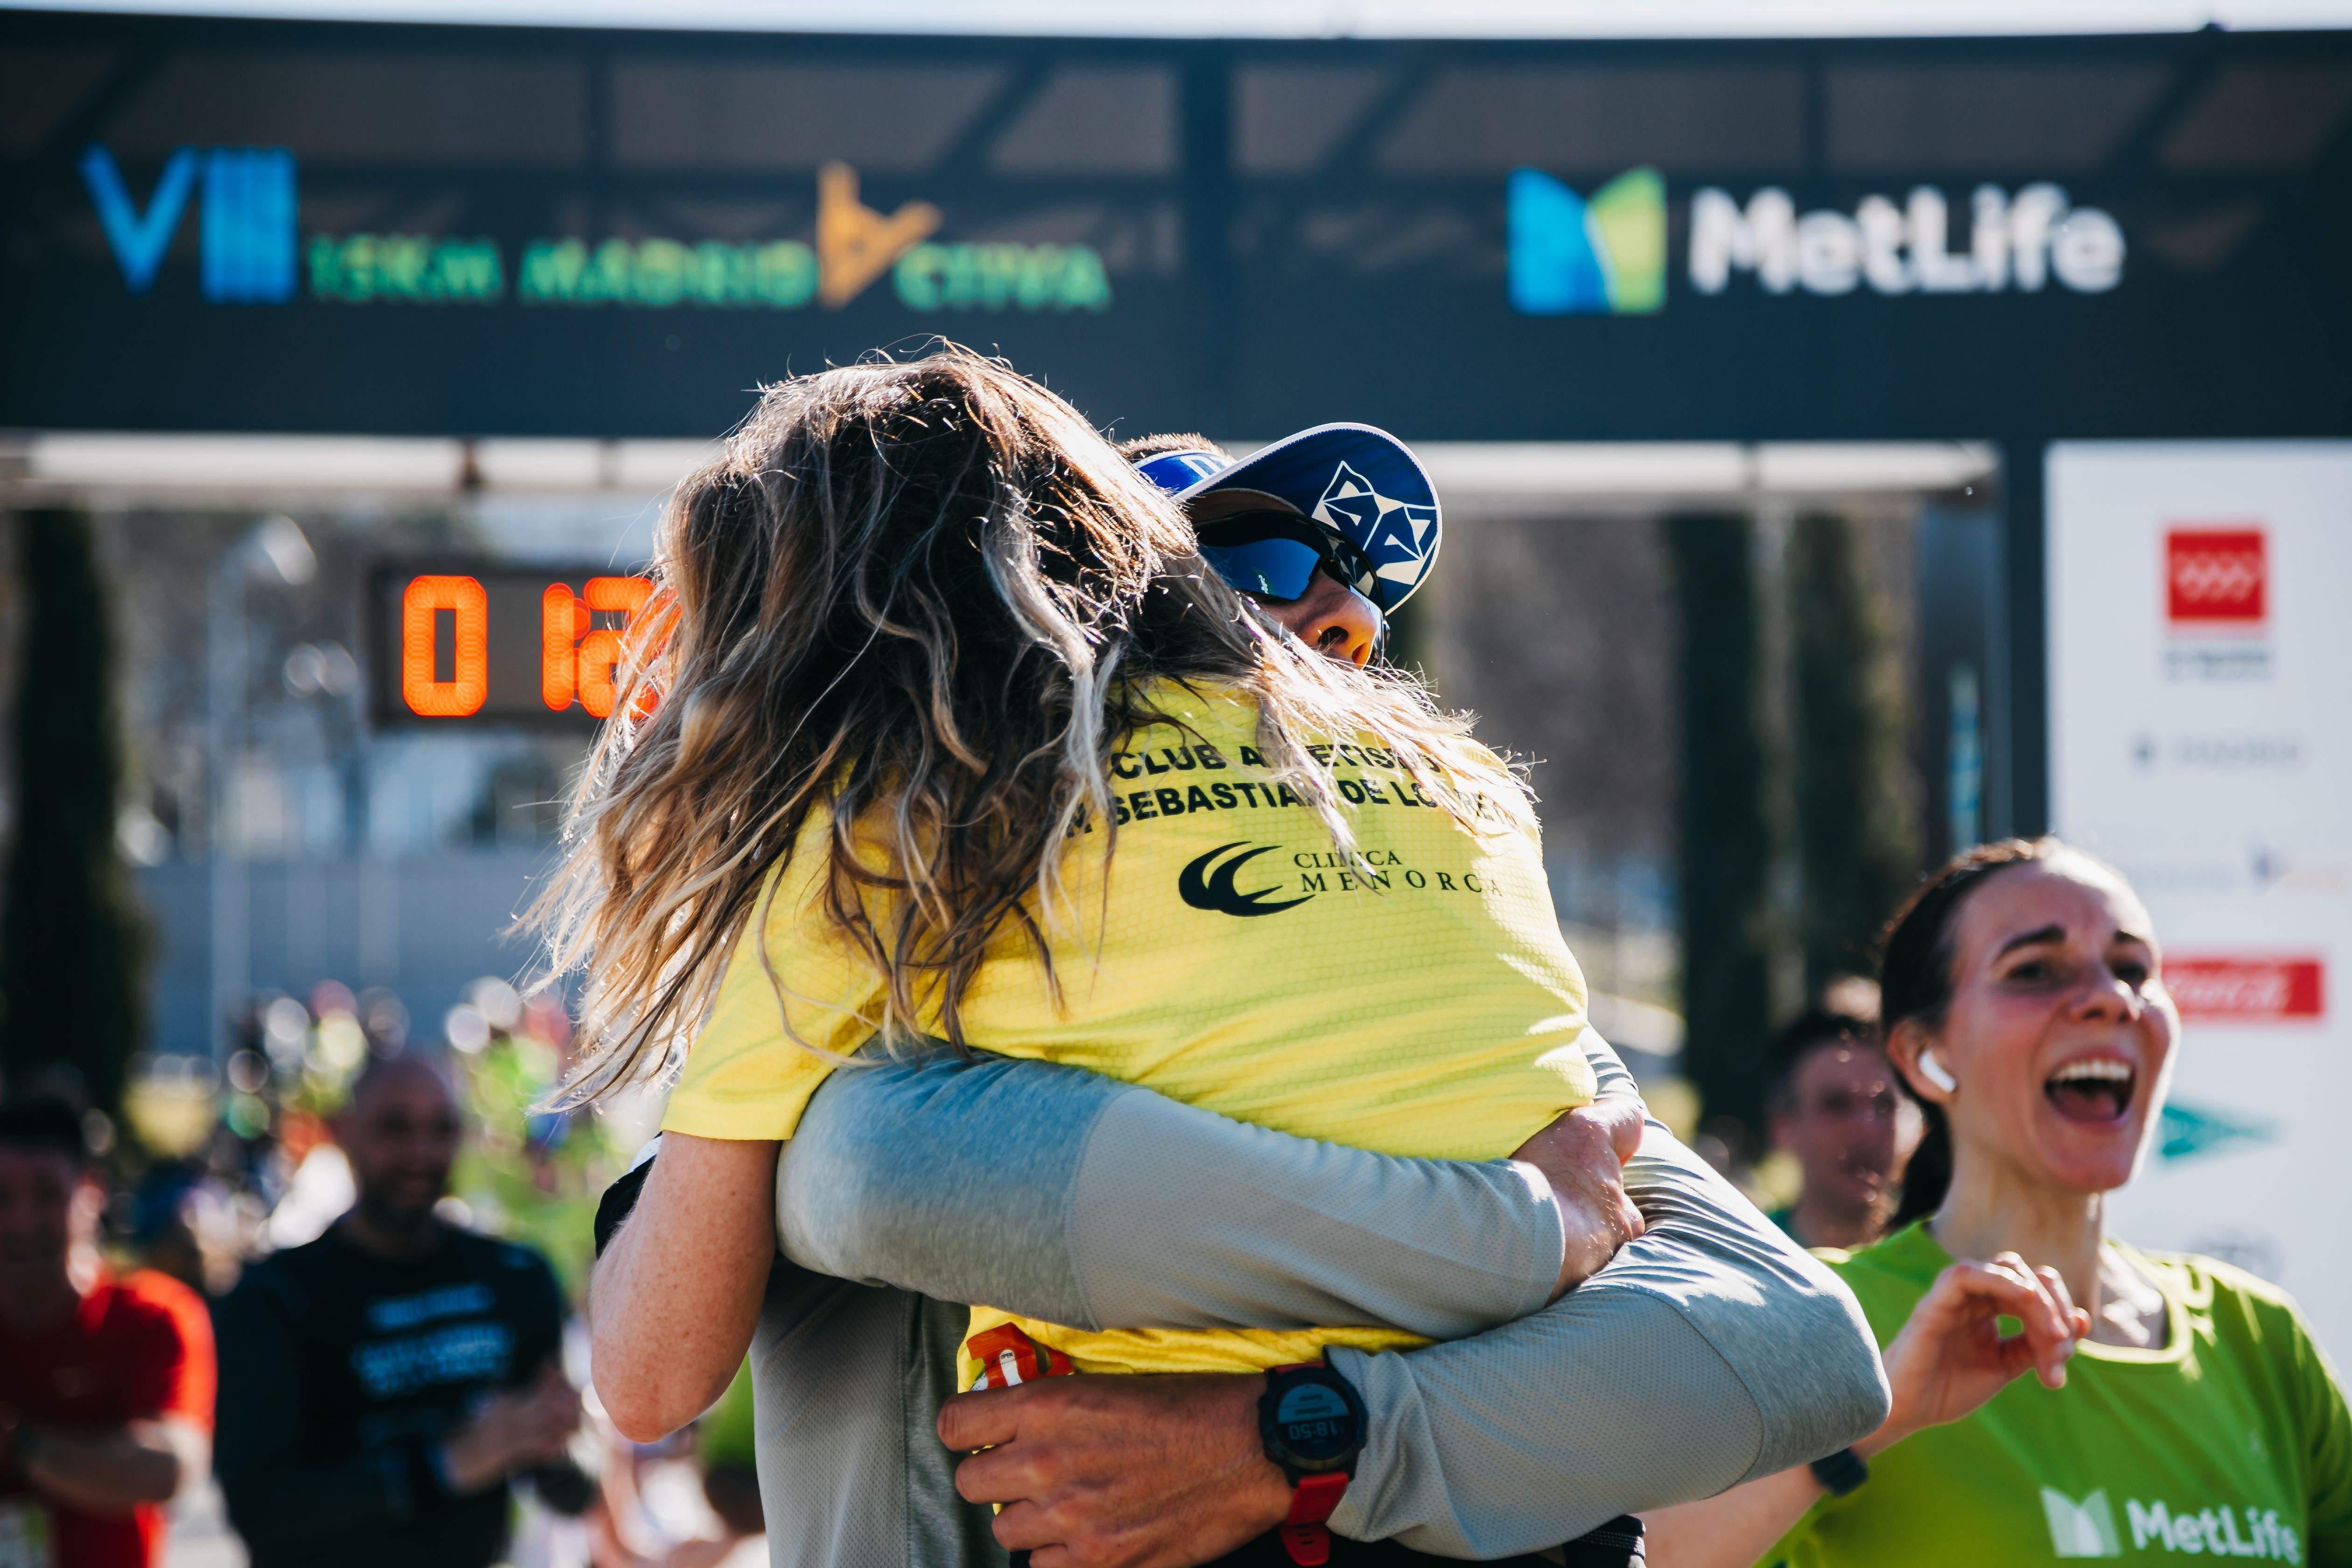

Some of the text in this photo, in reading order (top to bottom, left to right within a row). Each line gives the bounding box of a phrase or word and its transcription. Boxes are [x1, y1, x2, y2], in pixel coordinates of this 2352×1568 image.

[1689, 187, 2125, 294] MetLife
[1111, 745, 1227, 779] CLUB
[1111, 782, 1315, 826] SEBASTIA
[1337, 779, 1390, 805] DE
[1301, 870, 1503, 897] MENORCA
[2125, 1498, 2301, 1566] MetLife
